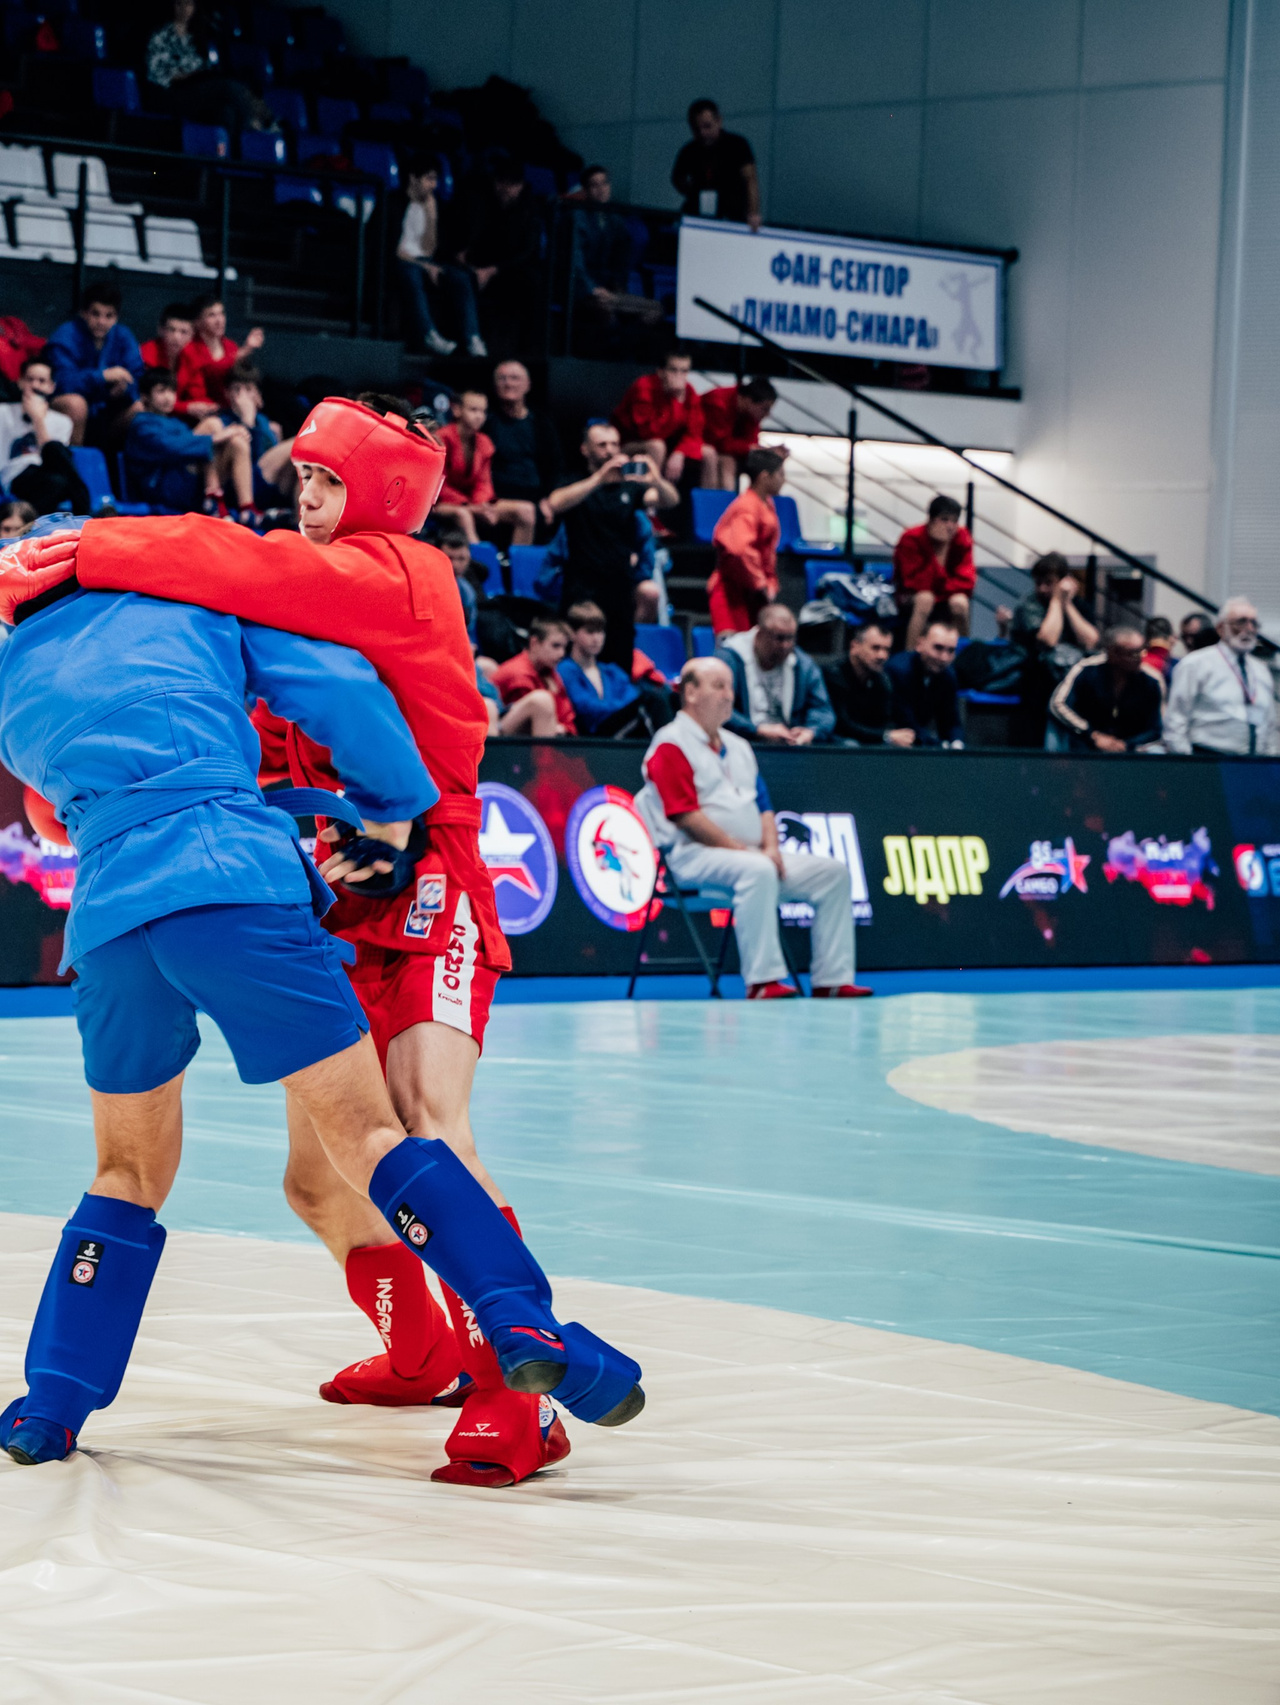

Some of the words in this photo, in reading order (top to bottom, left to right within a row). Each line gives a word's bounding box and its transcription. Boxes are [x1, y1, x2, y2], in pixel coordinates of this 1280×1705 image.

[770, 252, 910, 298] ФАН-СЕКТОР
[883, 835, 990, 904] ЛДПР
[376, 1277, 393, 1349] INSANE
[457, 1296, 484, 1348] ANE
